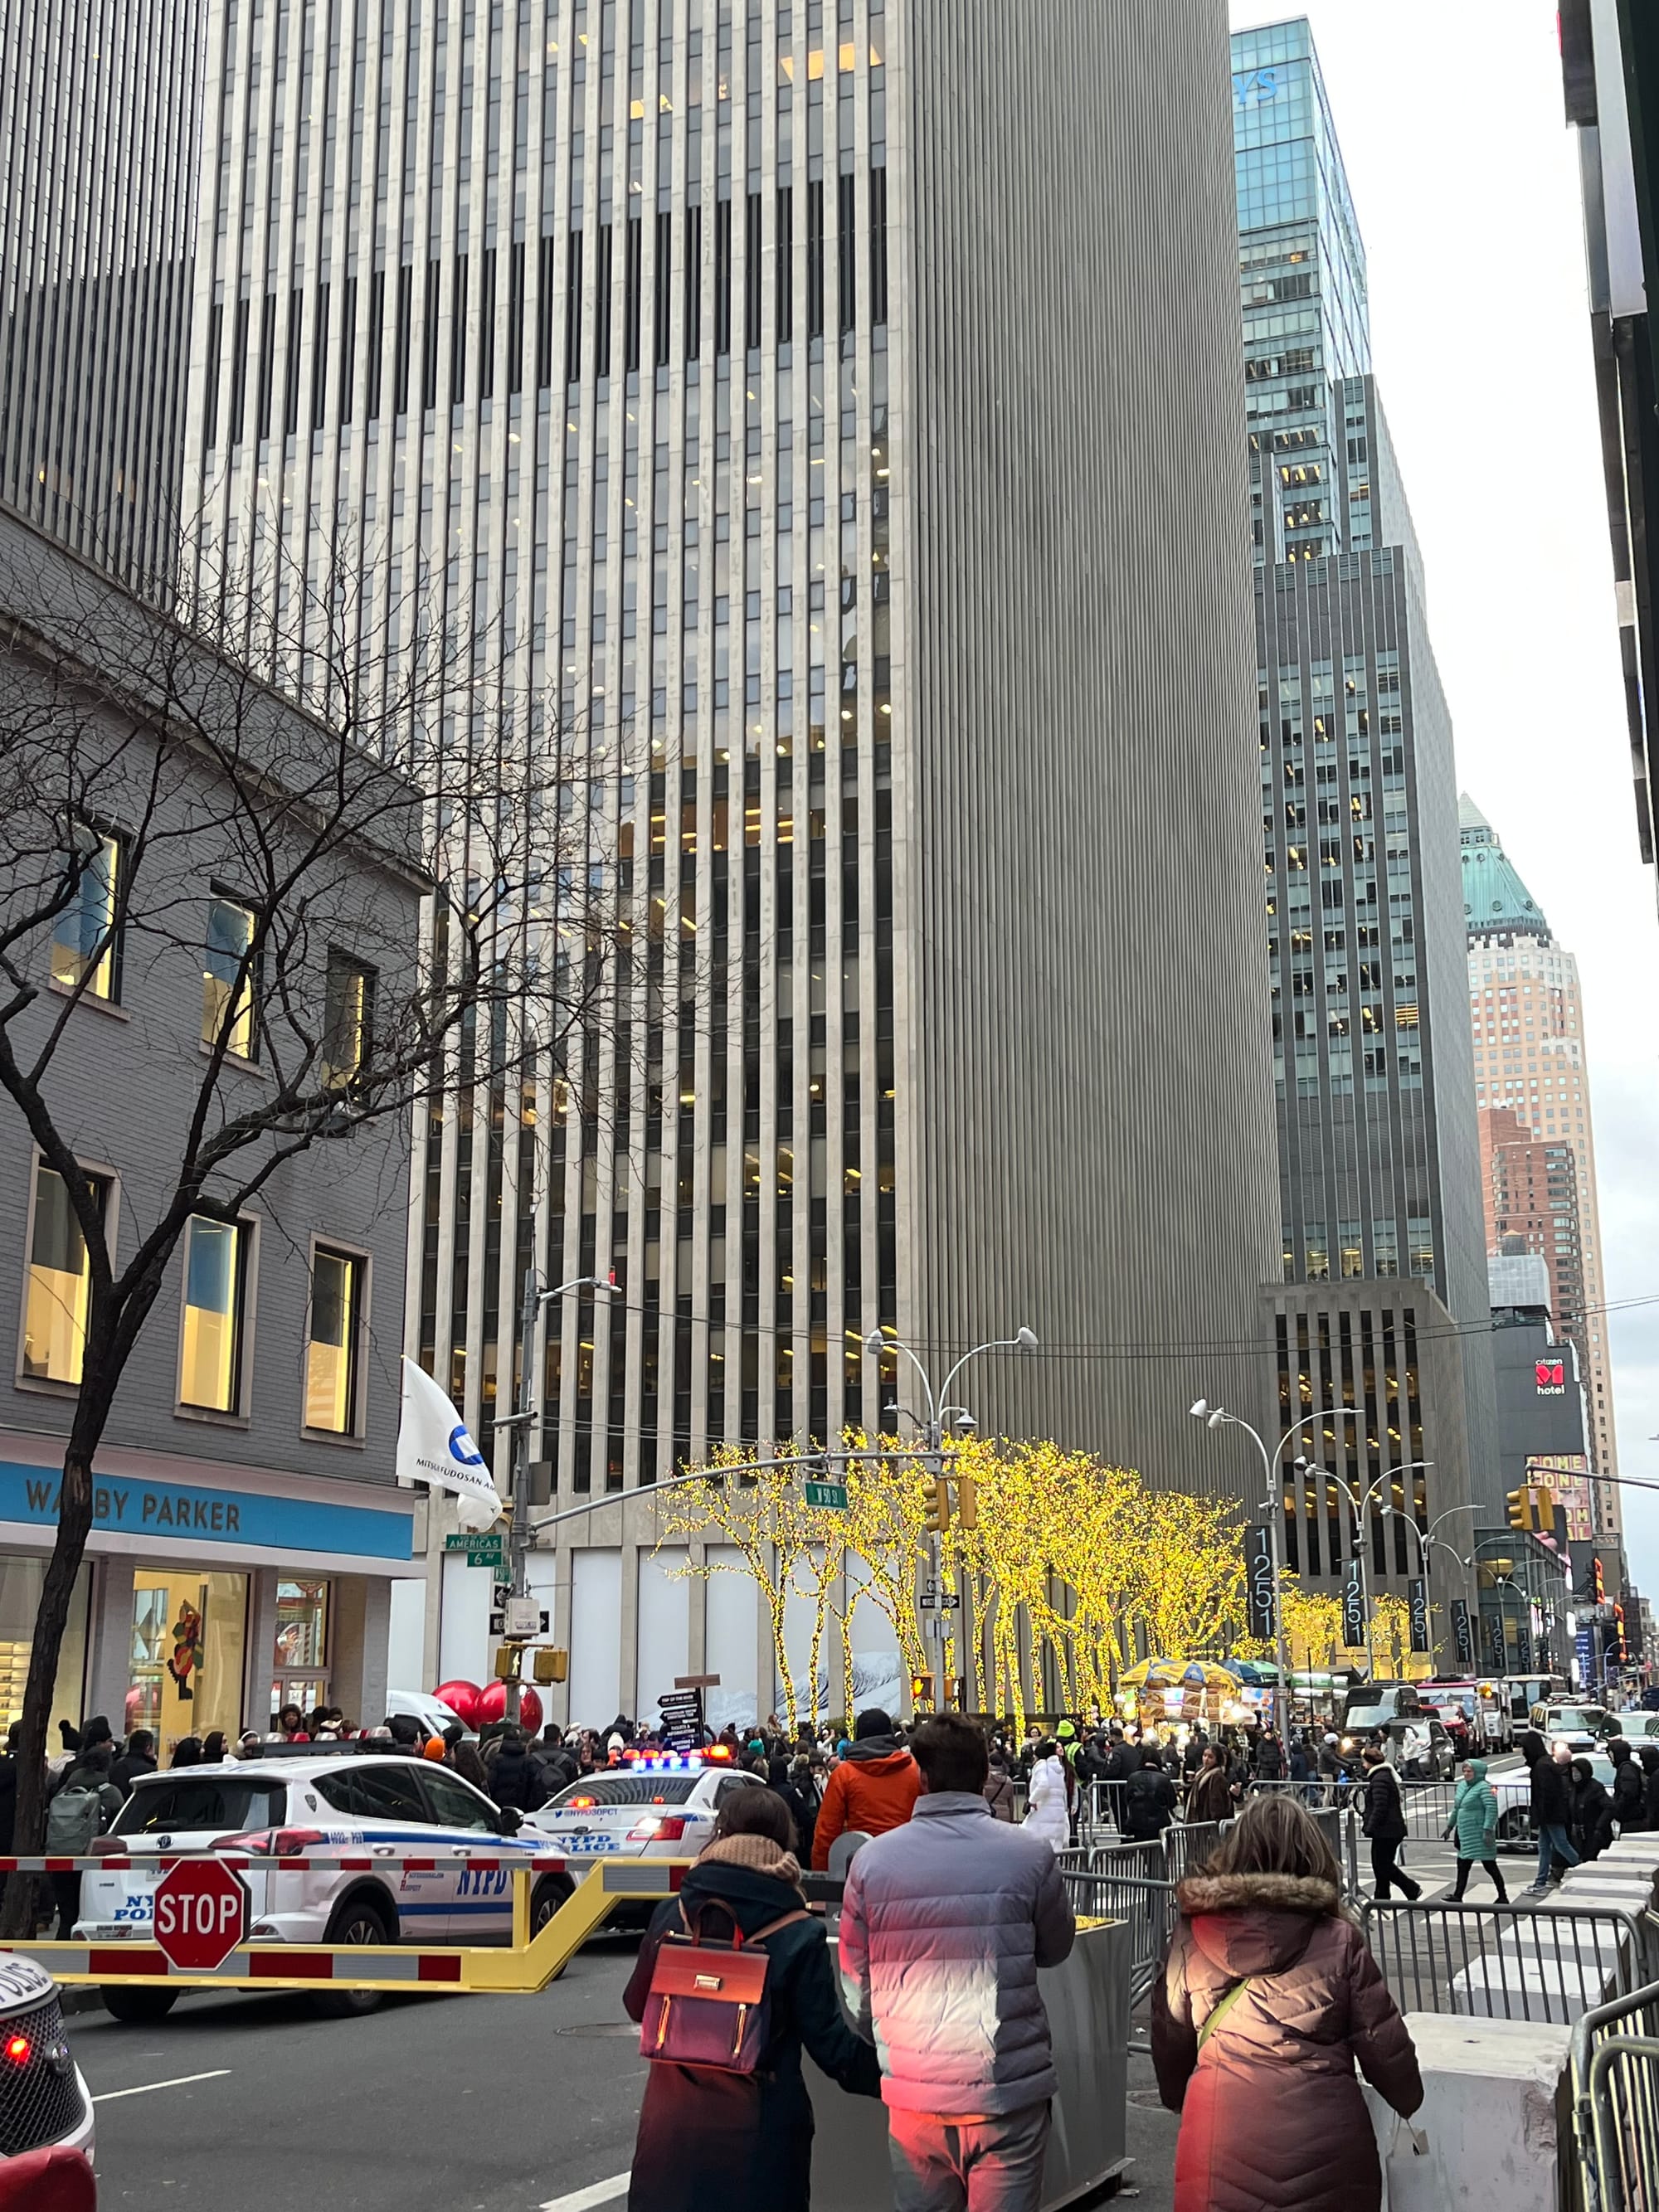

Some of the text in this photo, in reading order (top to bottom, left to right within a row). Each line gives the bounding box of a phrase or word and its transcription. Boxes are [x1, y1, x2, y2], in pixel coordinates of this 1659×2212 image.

[1233, 68, 1276, 105] YS
[1537, 1384, 1565, 1395] hotel
[440, 1466, 482, 1485] FUDOSAN
[26, 1479, 241, 1532] WBY PARKER
[823, 1488, 831, 1504] 50
[449, 1539, 499, 1548] AMERICAS
[474, 1553, 483, 1565] 6
[1253, 1528, 1272, 1636] 1251
[1346, 1559, 1361, 1646] 1251
[1413, 1581, 1426, 1650] 1251
[571, 1842, 620, 1852] LICE
[456, 1870, 507, 1895] NYPD
[158, 1894, 239, 1935] STOP
[0, 1962, 48, 2002] OLICE
